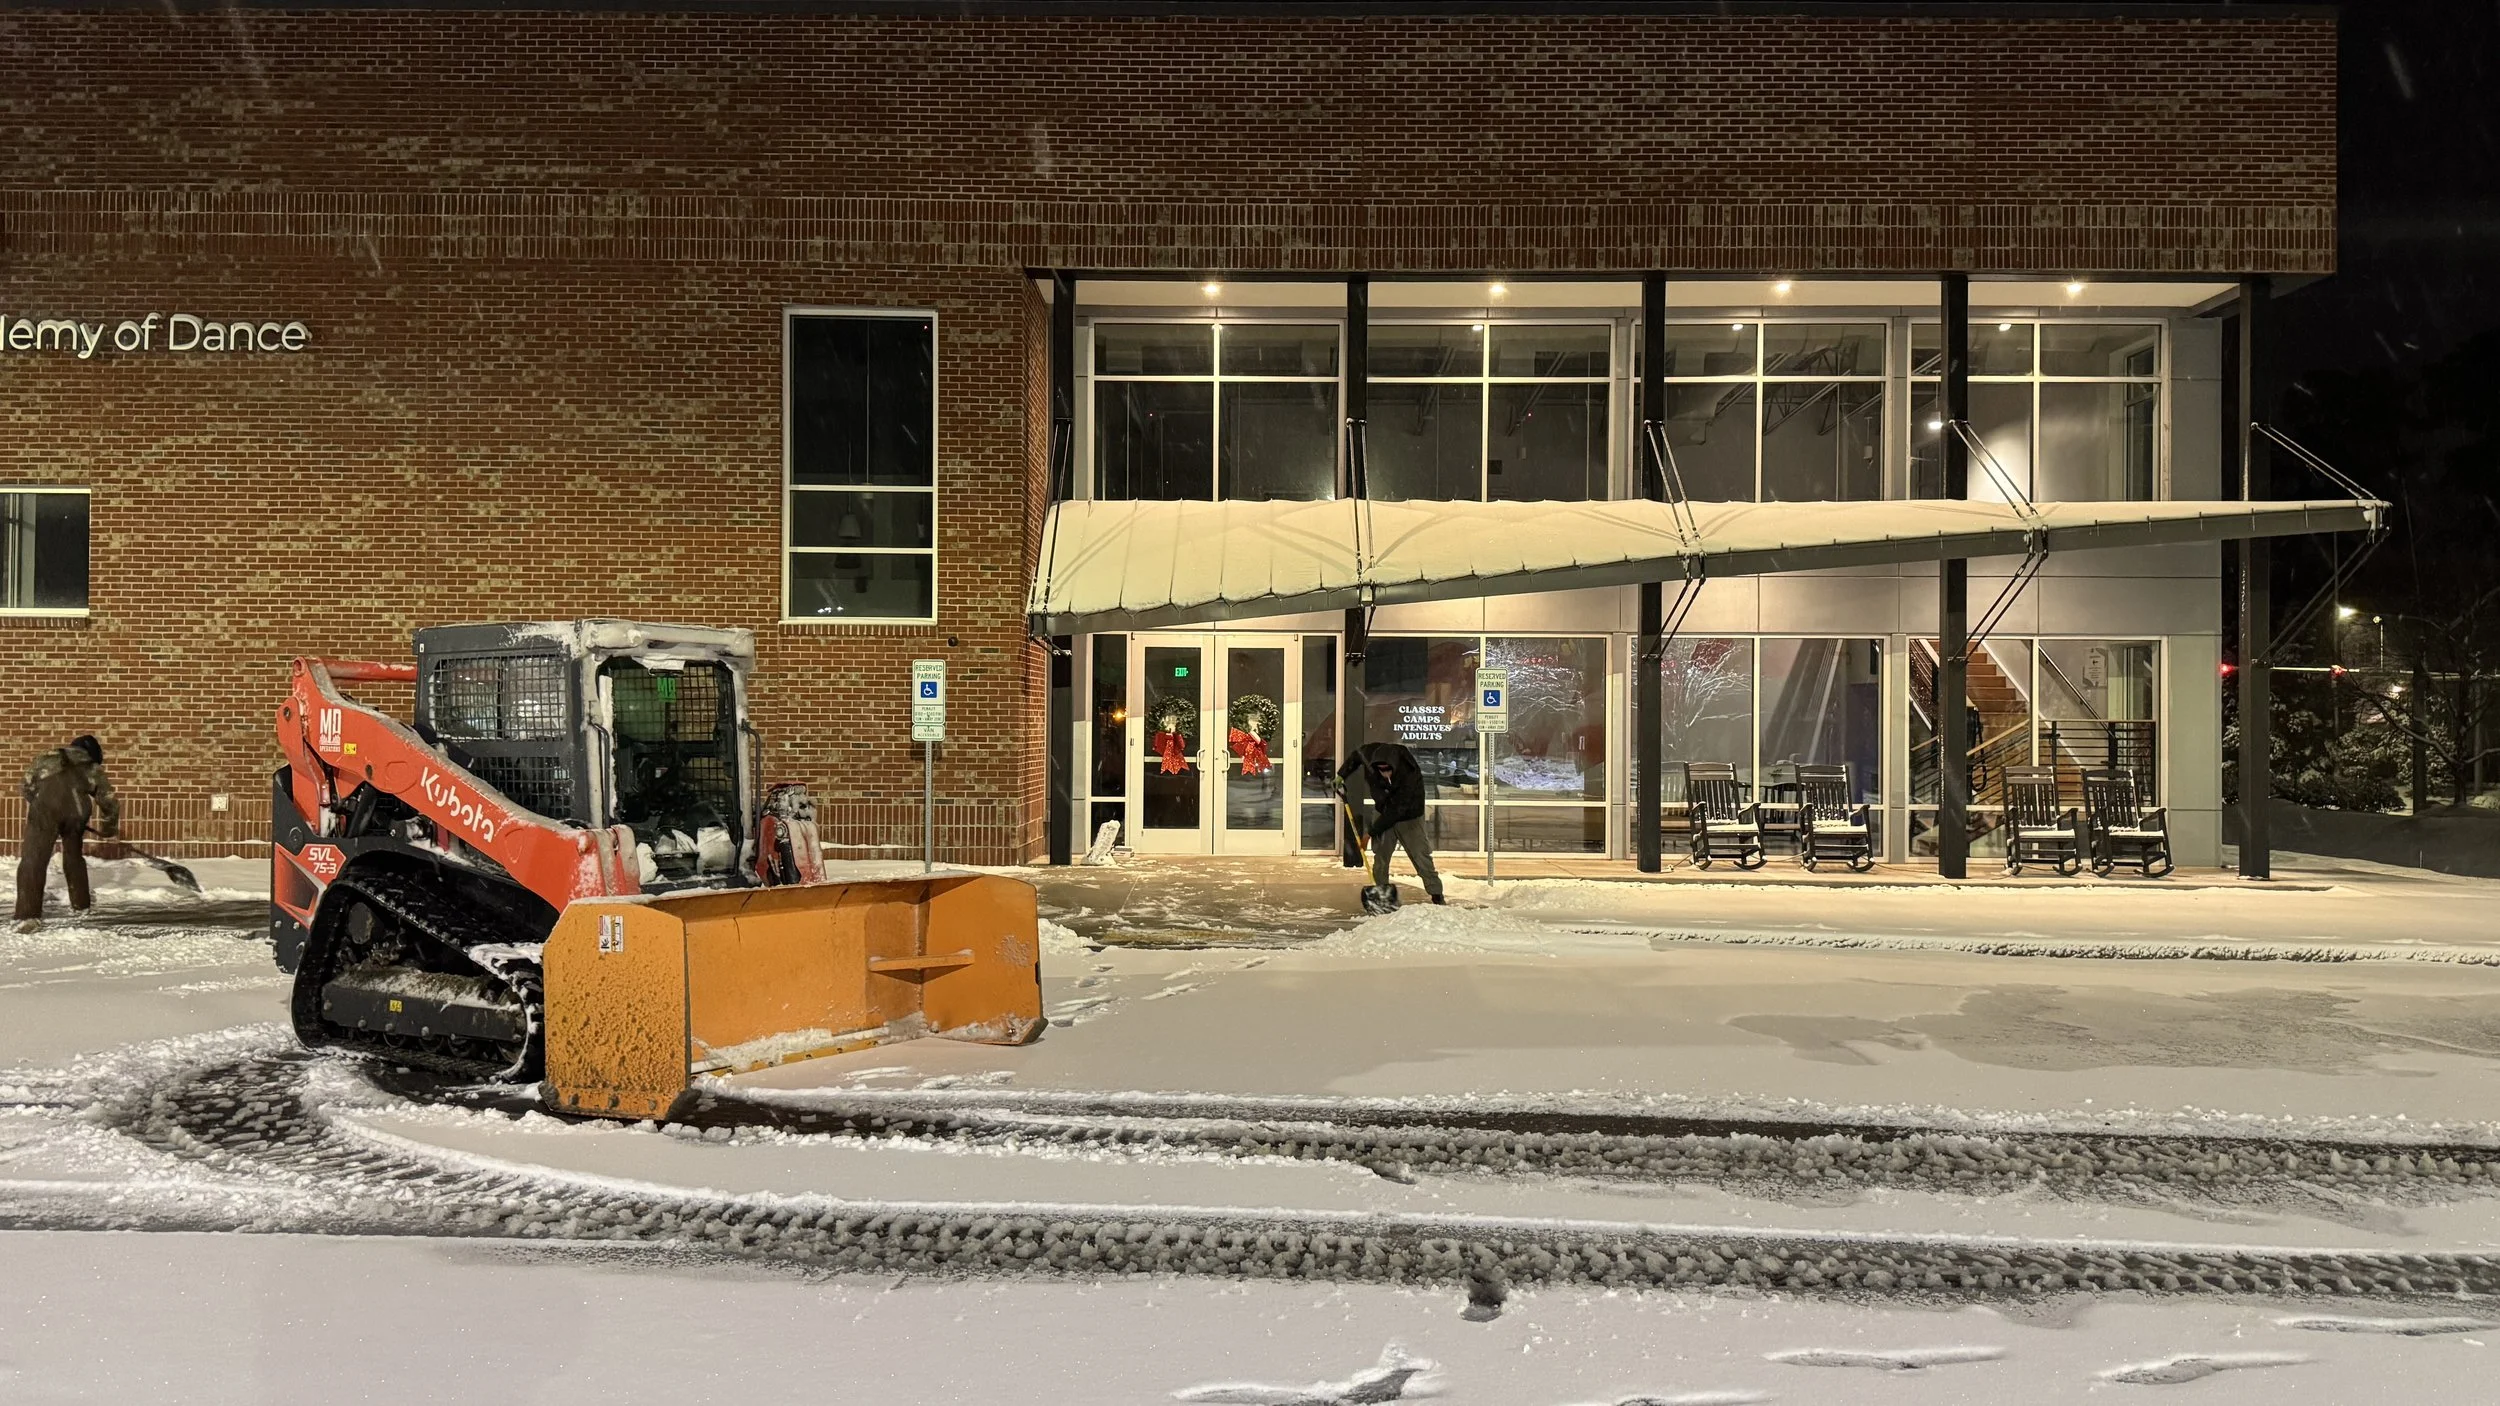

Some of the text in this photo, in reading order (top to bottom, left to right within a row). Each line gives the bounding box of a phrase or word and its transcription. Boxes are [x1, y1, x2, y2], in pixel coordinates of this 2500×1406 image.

[114, 313, 160, 351] of
[169, 315, 310, 351] Dance
[1398, 705, 1446, 714] CLASSES
[1403, 715, 1441, 724] CAMPS
[1393, 723, 1452, 732] INTENSIVES
[1401, 732, 1443, 740] ADULTS
[420, 766, 494, 843] Kubota
[308, 847, 335, 862] SVL
[313, 862, 337, 873] 75-3
